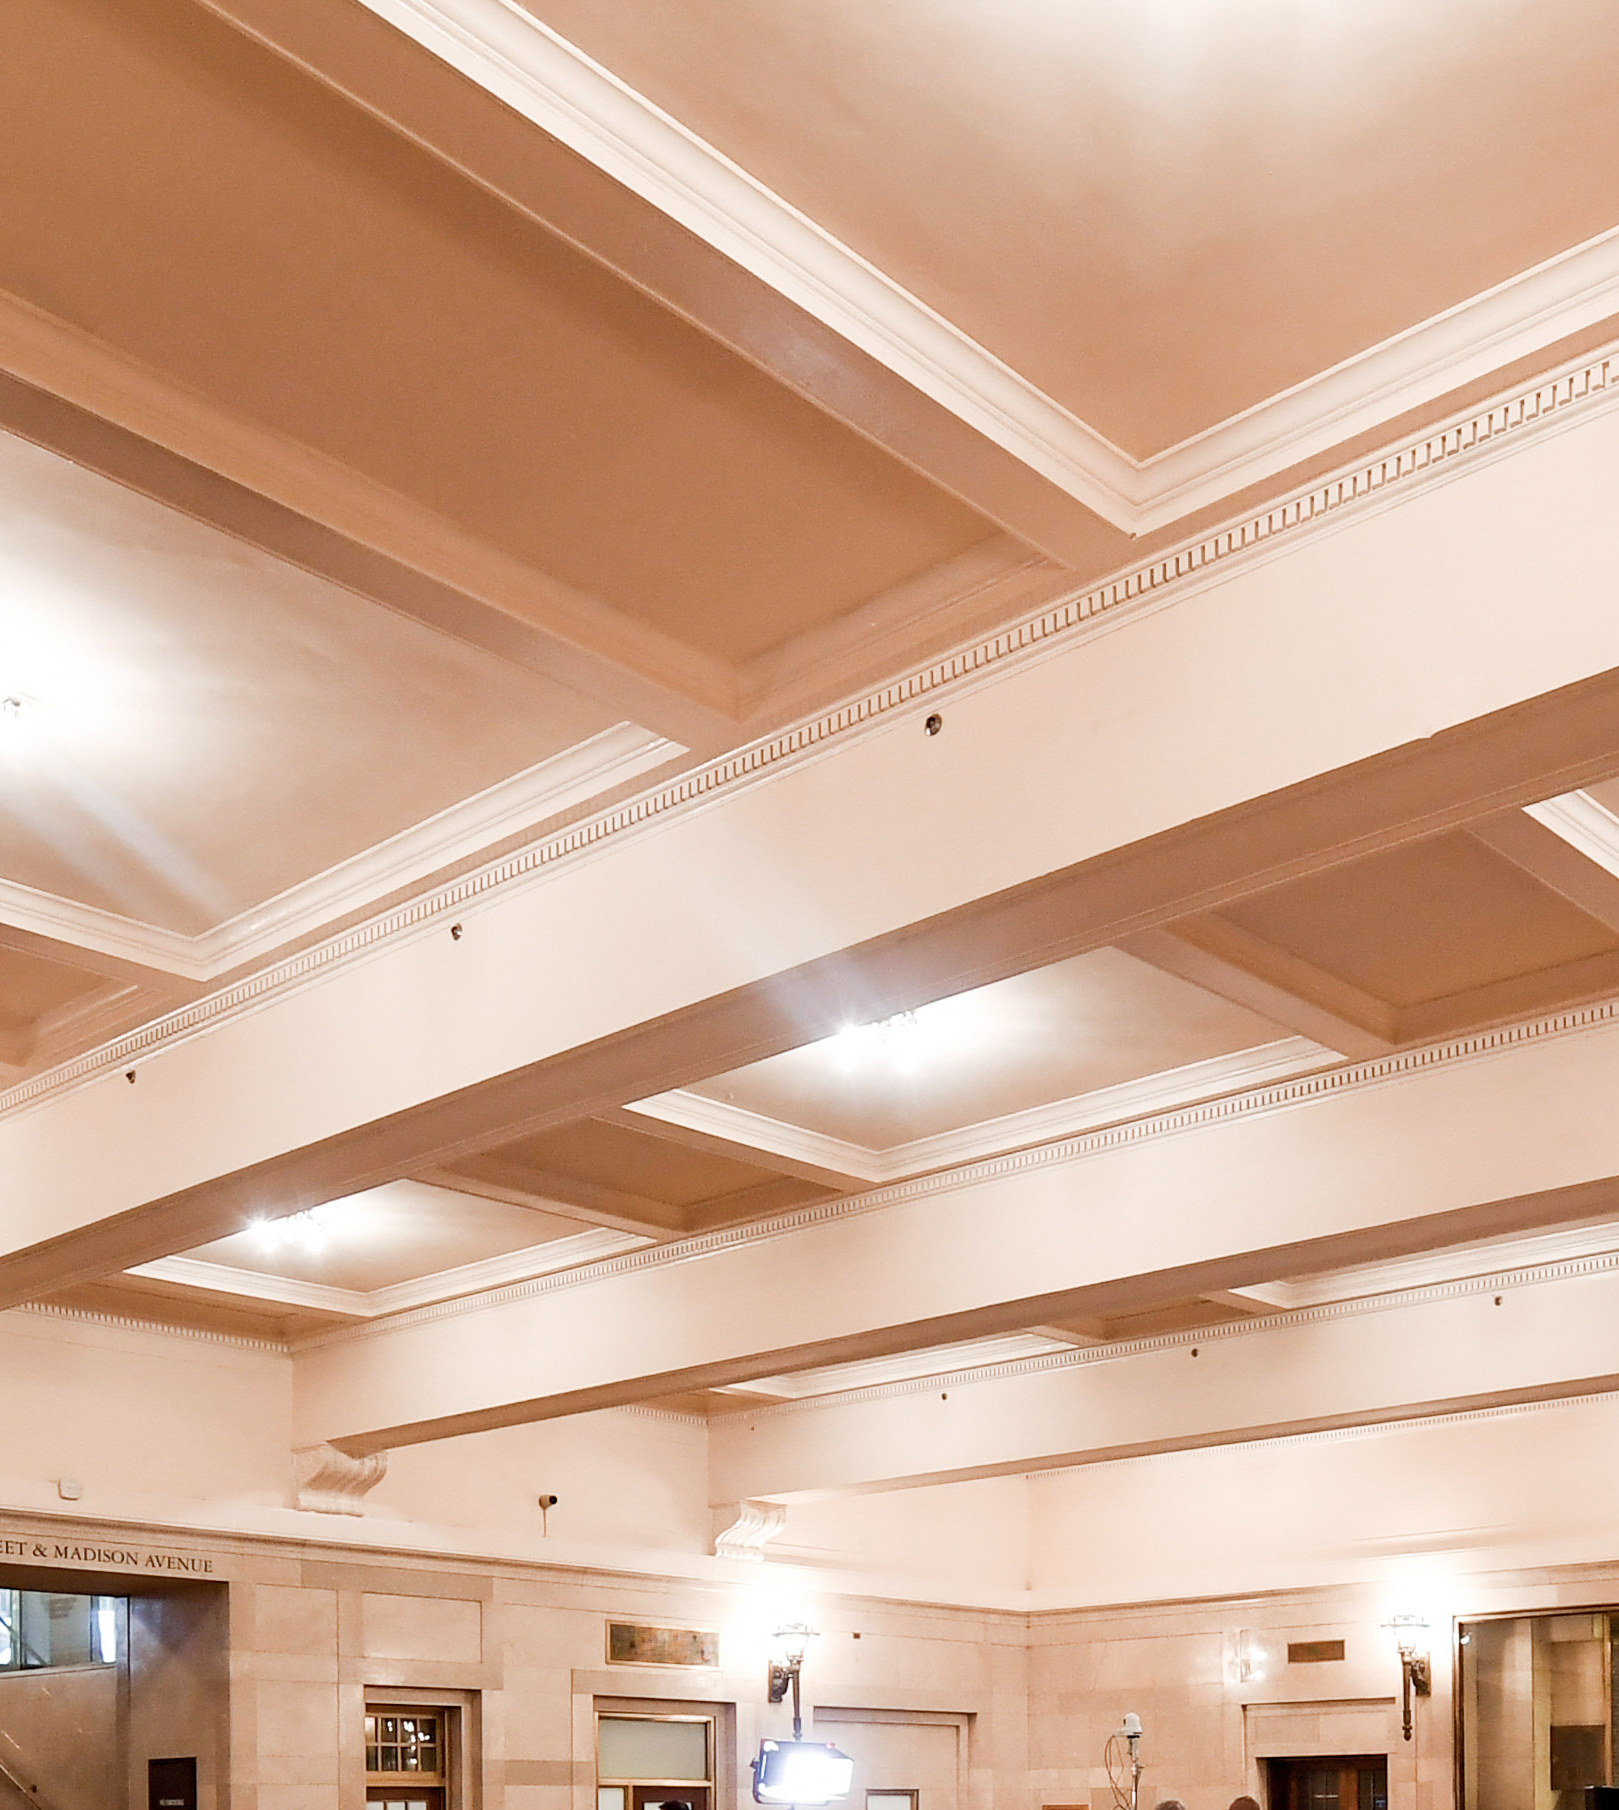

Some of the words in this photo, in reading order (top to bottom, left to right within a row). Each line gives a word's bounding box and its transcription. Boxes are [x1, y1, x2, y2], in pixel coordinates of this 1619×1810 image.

[32, 1543, 48, 1559] &
[54, 1544, 139, 1567] MADISON
[145, 1555, 213, 1574] AVENUE
